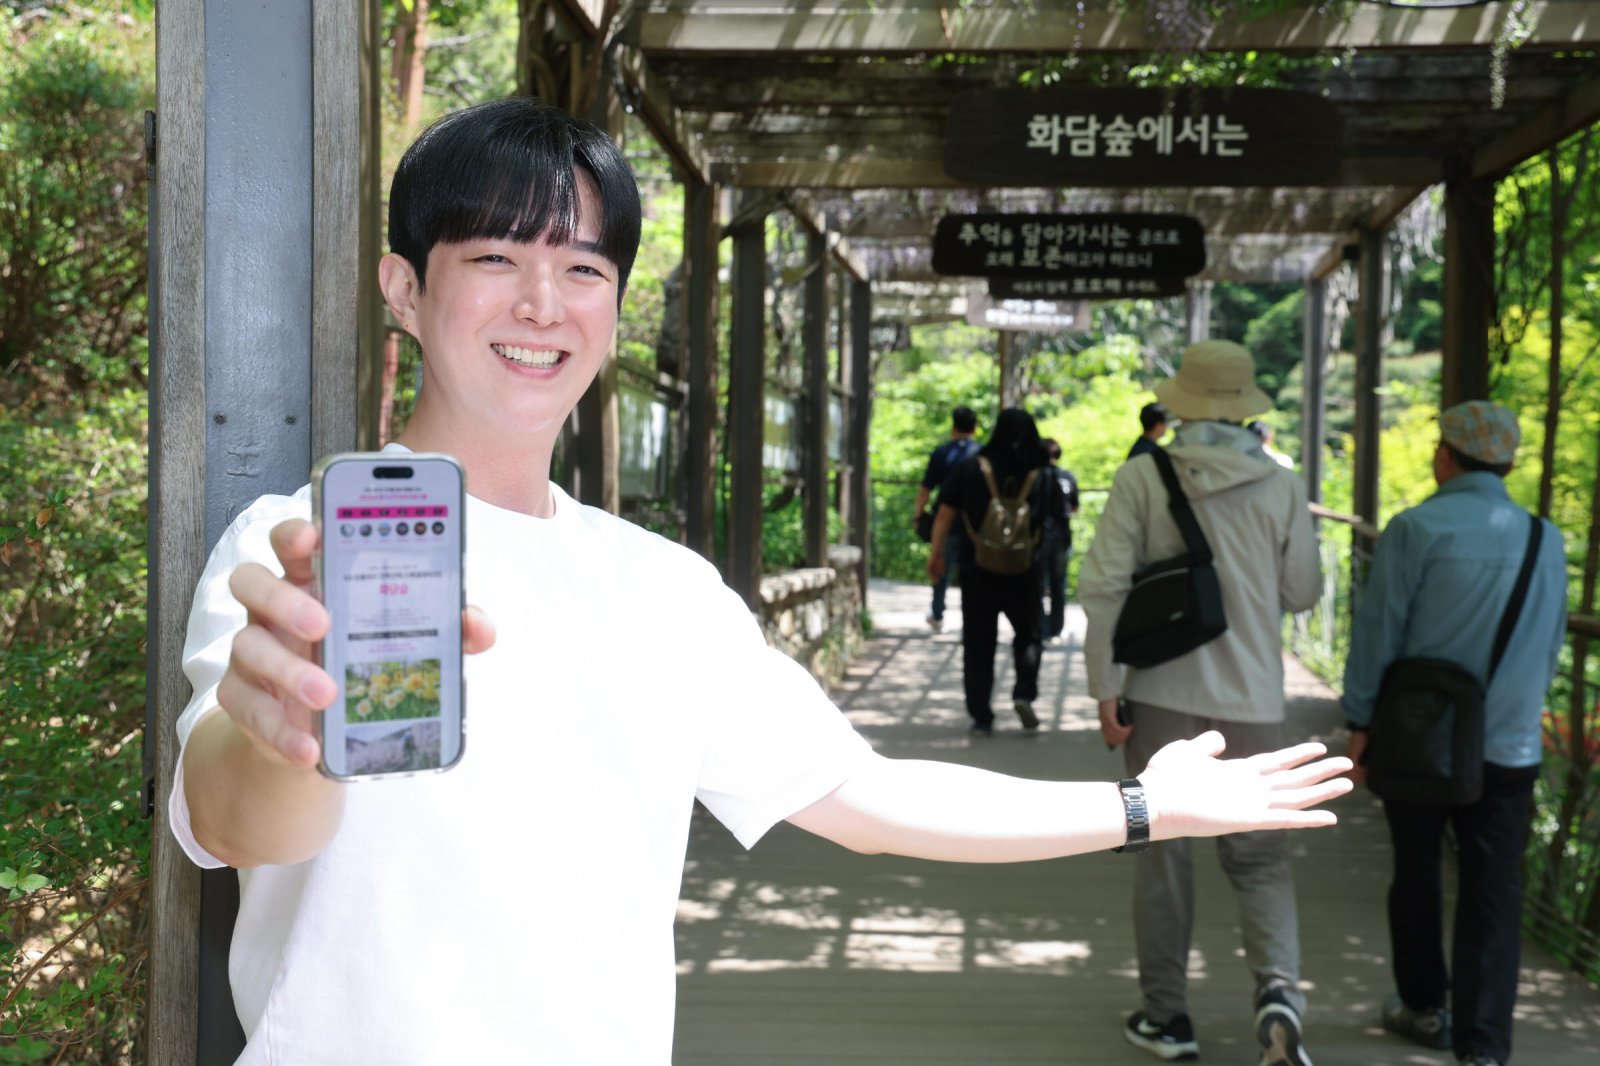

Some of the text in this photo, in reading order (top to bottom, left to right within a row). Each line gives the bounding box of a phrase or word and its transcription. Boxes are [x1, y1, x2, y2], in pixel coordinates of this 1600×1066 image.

[1027, 114, 1248, 156] 화담숲에서는
[958, 222, 1014, 246] 추억을
[1021, 222, 1131, 247] 담아가시는
